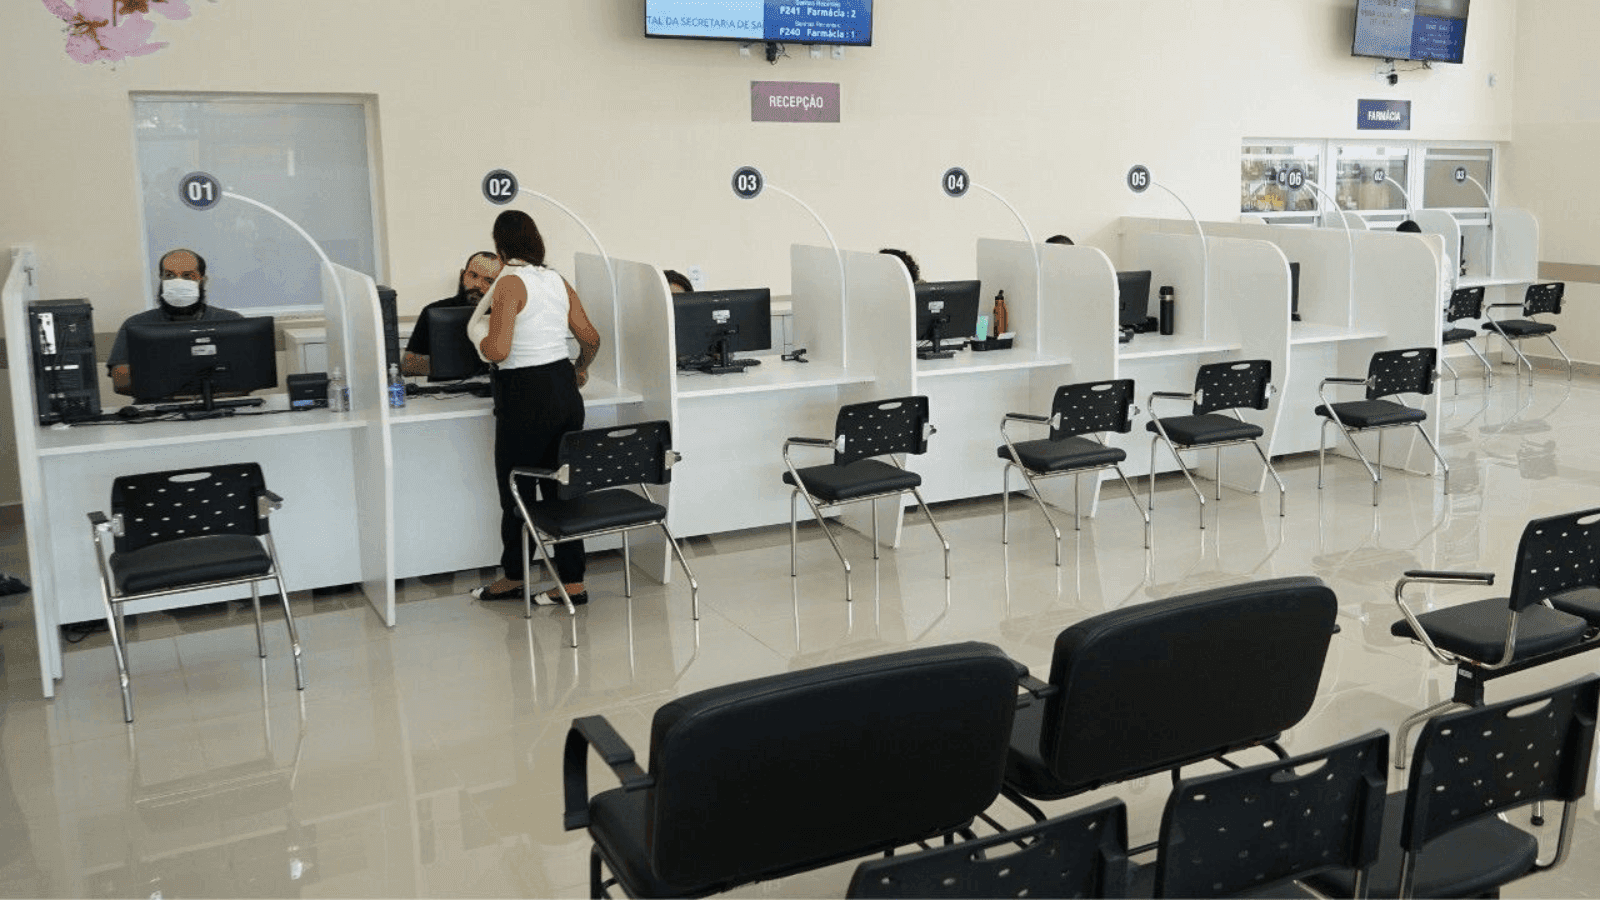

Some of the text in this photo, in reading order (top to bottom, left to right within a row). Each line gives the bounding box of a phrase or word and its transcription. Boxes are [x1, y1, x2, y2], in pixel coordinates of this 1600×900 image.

[780, 6, 801, 16] F241
[665, 16, 679, 26] DA
[680, 16, 736, 28] SECRETARIA
[737, 19, 749, 29] DE
[780, 27, 801, 37] F240
[769, 94, 823, 111] RECEPÇÃO
[1367, 109, 1401, 121] FARMÁCIA
[738, 174, 757, 191] 03
[948, 174, 965, 191] 04
[1131, 171, 1147, 187] 05
[1289, 171, 1302, 186] 06
[1374, 170, 1384, 181] 02
[188, 181, 213, 201] 01
[489, 178, 512, 196] 02
